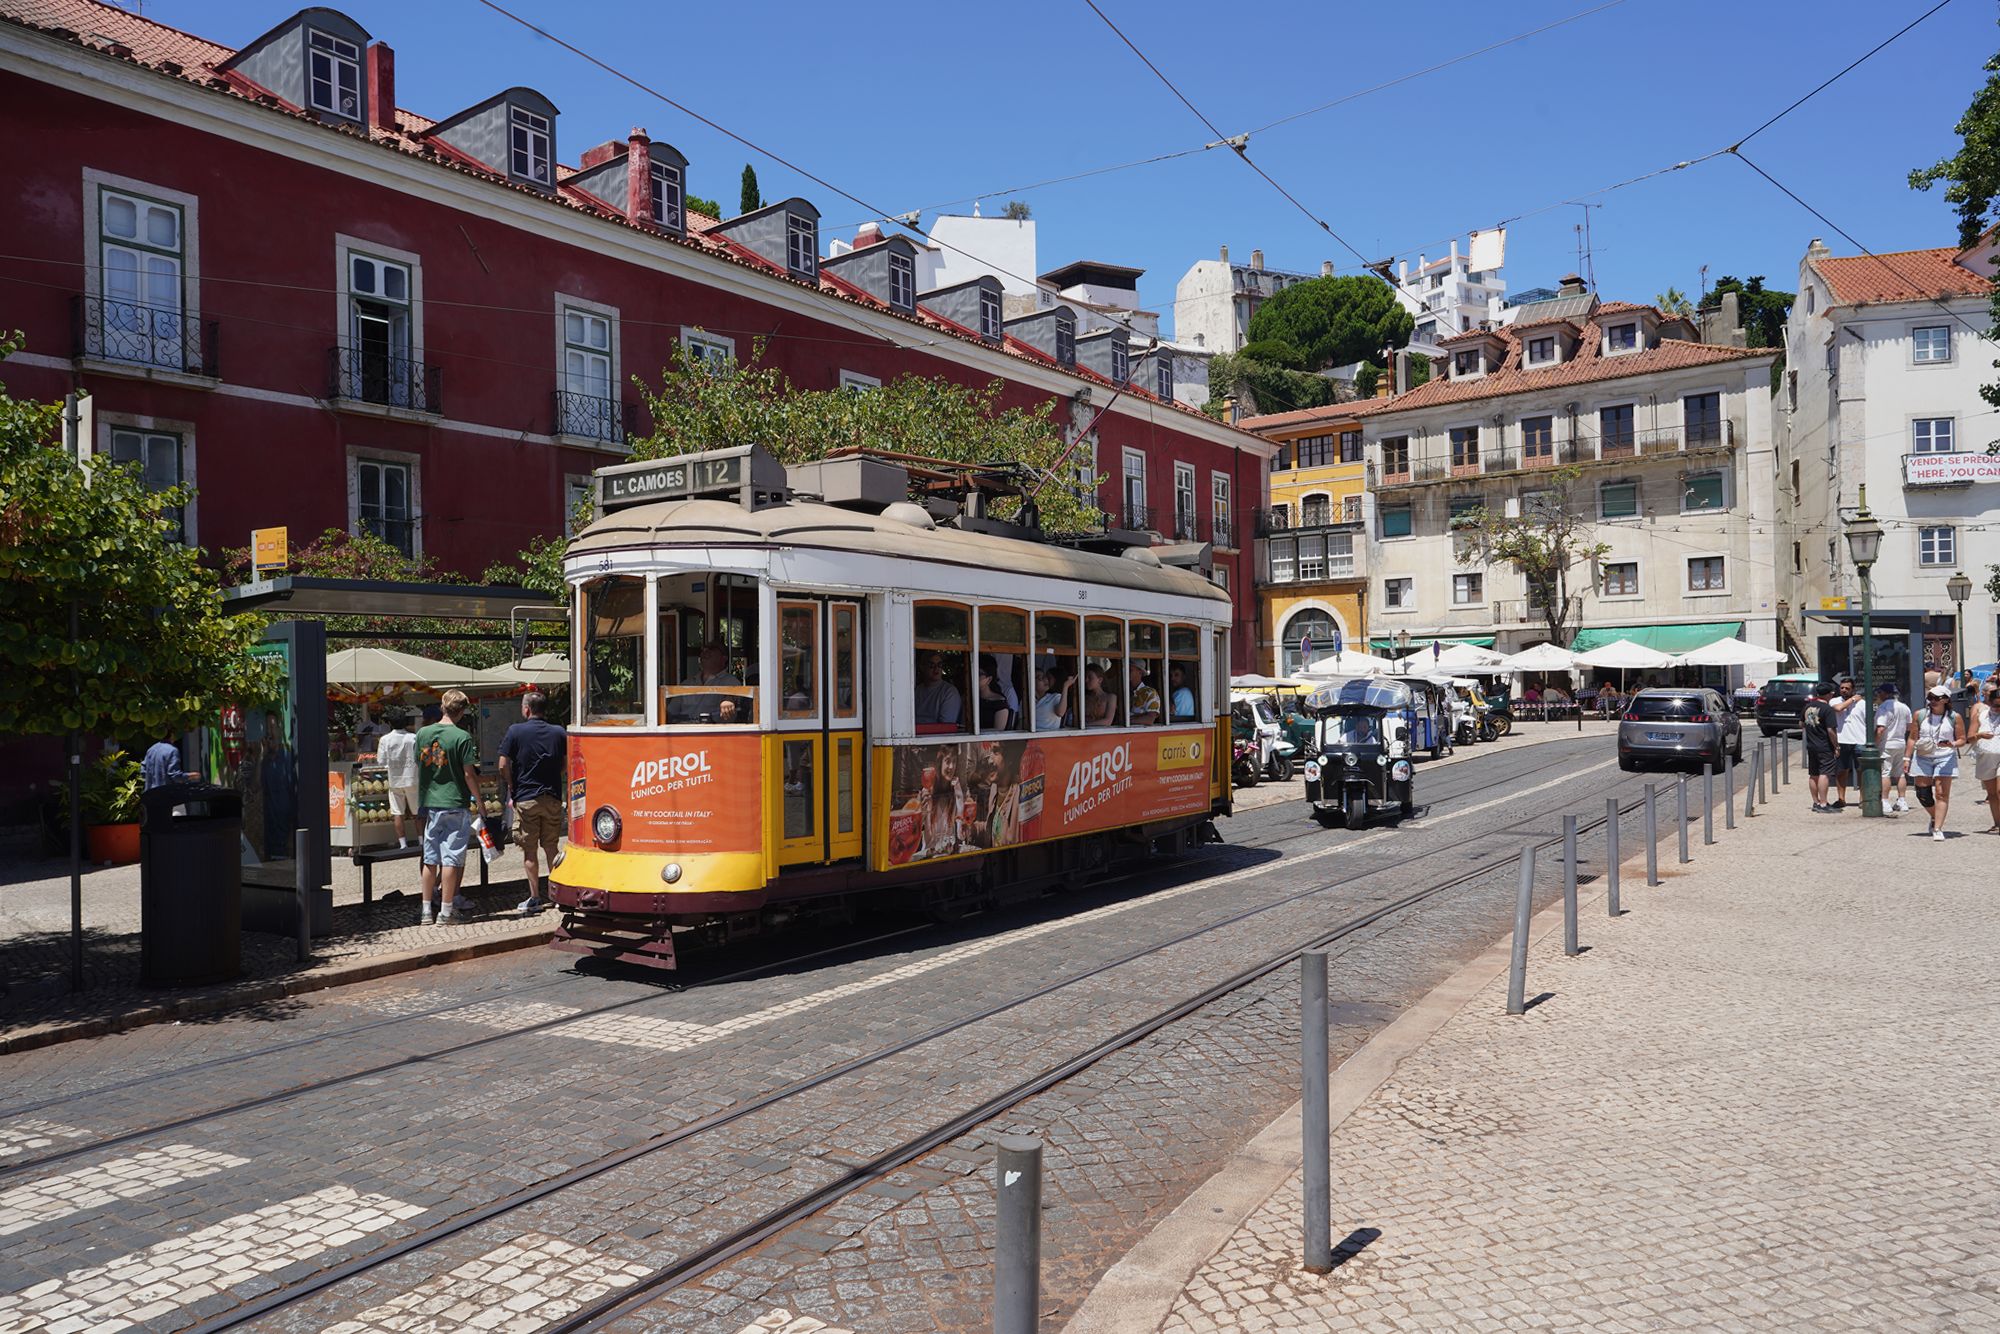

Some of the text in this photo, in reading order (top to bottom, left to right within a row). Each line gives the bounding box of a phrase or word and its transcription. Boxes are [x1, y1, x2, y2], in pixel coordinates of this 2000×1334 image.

[1911, 456, 1961, 467] VENDE-SE
[705, 460, 728, 484] 12
[1951, 468, 1975, 477] YOU
[599, 559, 613, 571] 581
[1078, 590, 1087, 600] 581
[1162, 742, 1187, 760] carris
[631, 751, 711, 788] APEROL
[1064, 741, 1133, 805] APEROL
[631, 773, 713, 800] L'UNICO. PER TUTTI.
[1064, 797, 1097, 825] L'UNICO.
[1098, 787, 1111, 805] PER
[1112, 775, 1133, 796] TUTTI.
[653, 810, 684, 818] COCKTAIL
